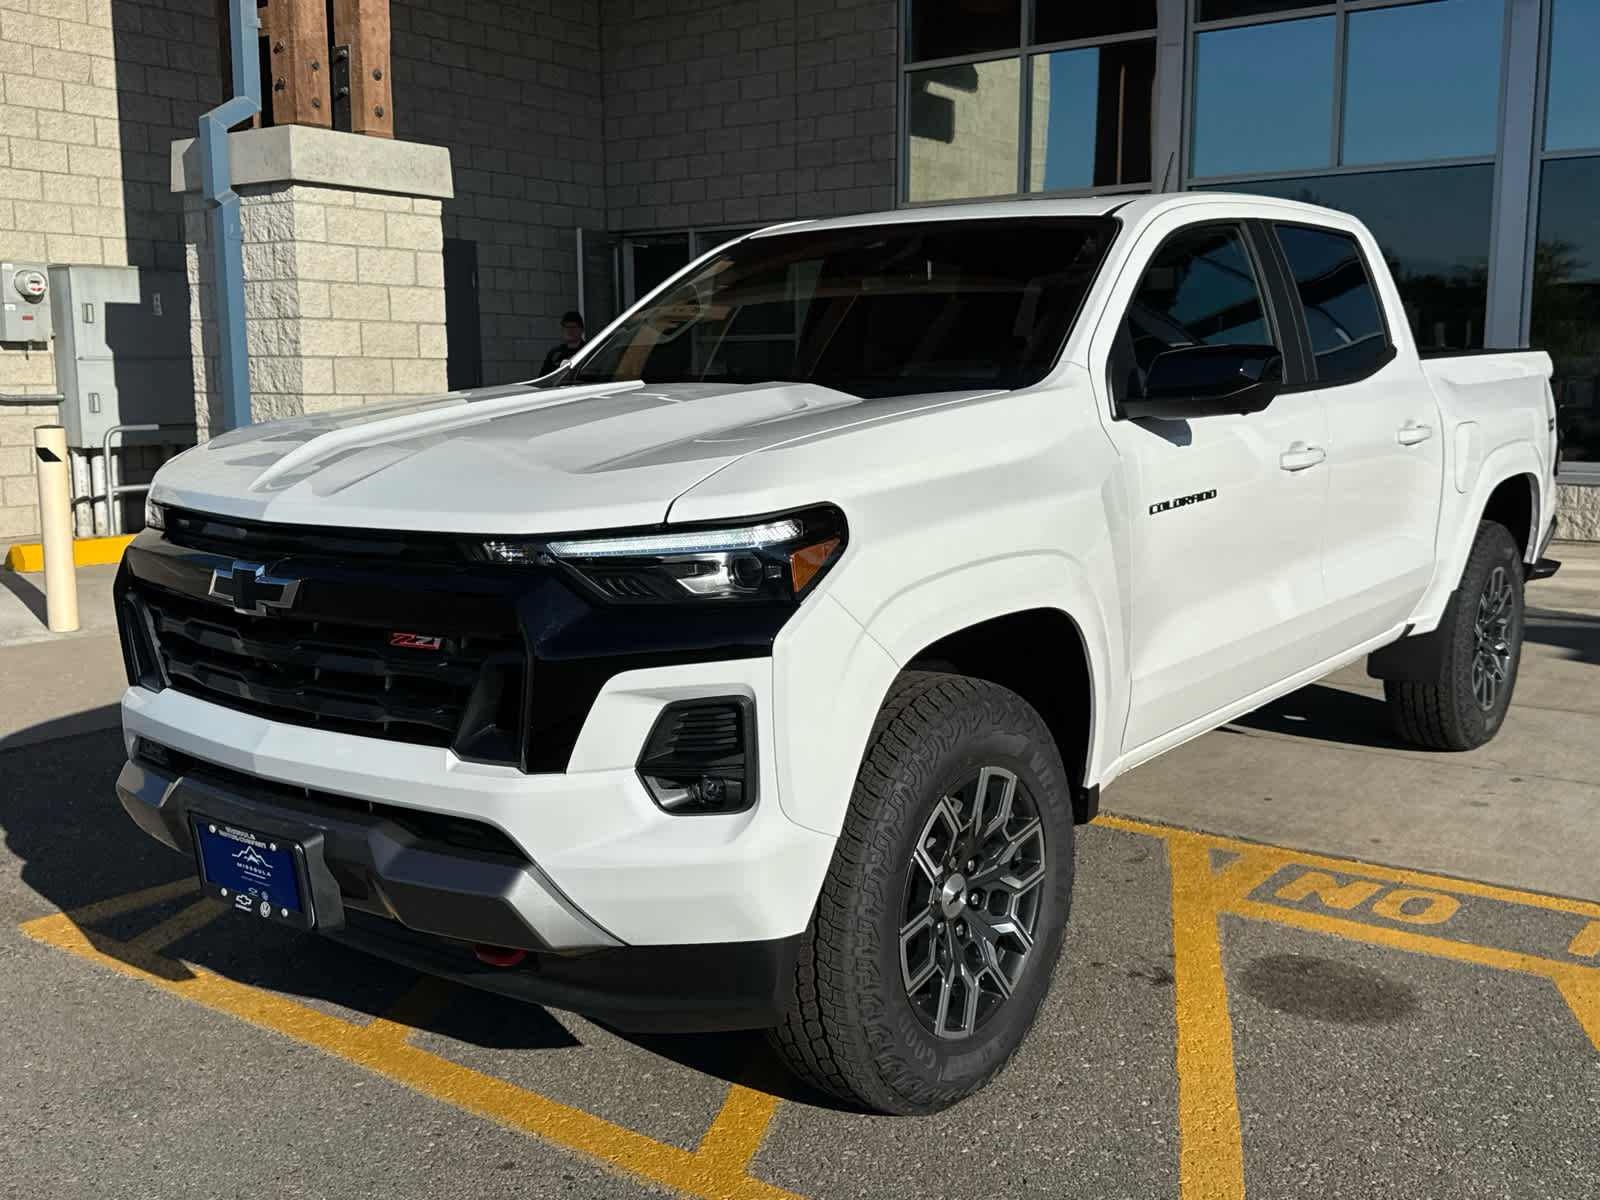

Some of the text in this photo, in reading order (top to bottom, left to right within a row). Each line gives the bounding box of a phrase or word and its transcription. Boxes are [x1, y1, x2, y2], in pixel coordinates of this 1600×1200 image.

[1149, 489, 1218, 515] COLORADO
[390, 632, 441, 650] Z71
[1274, 871, 1461, 924] NO
